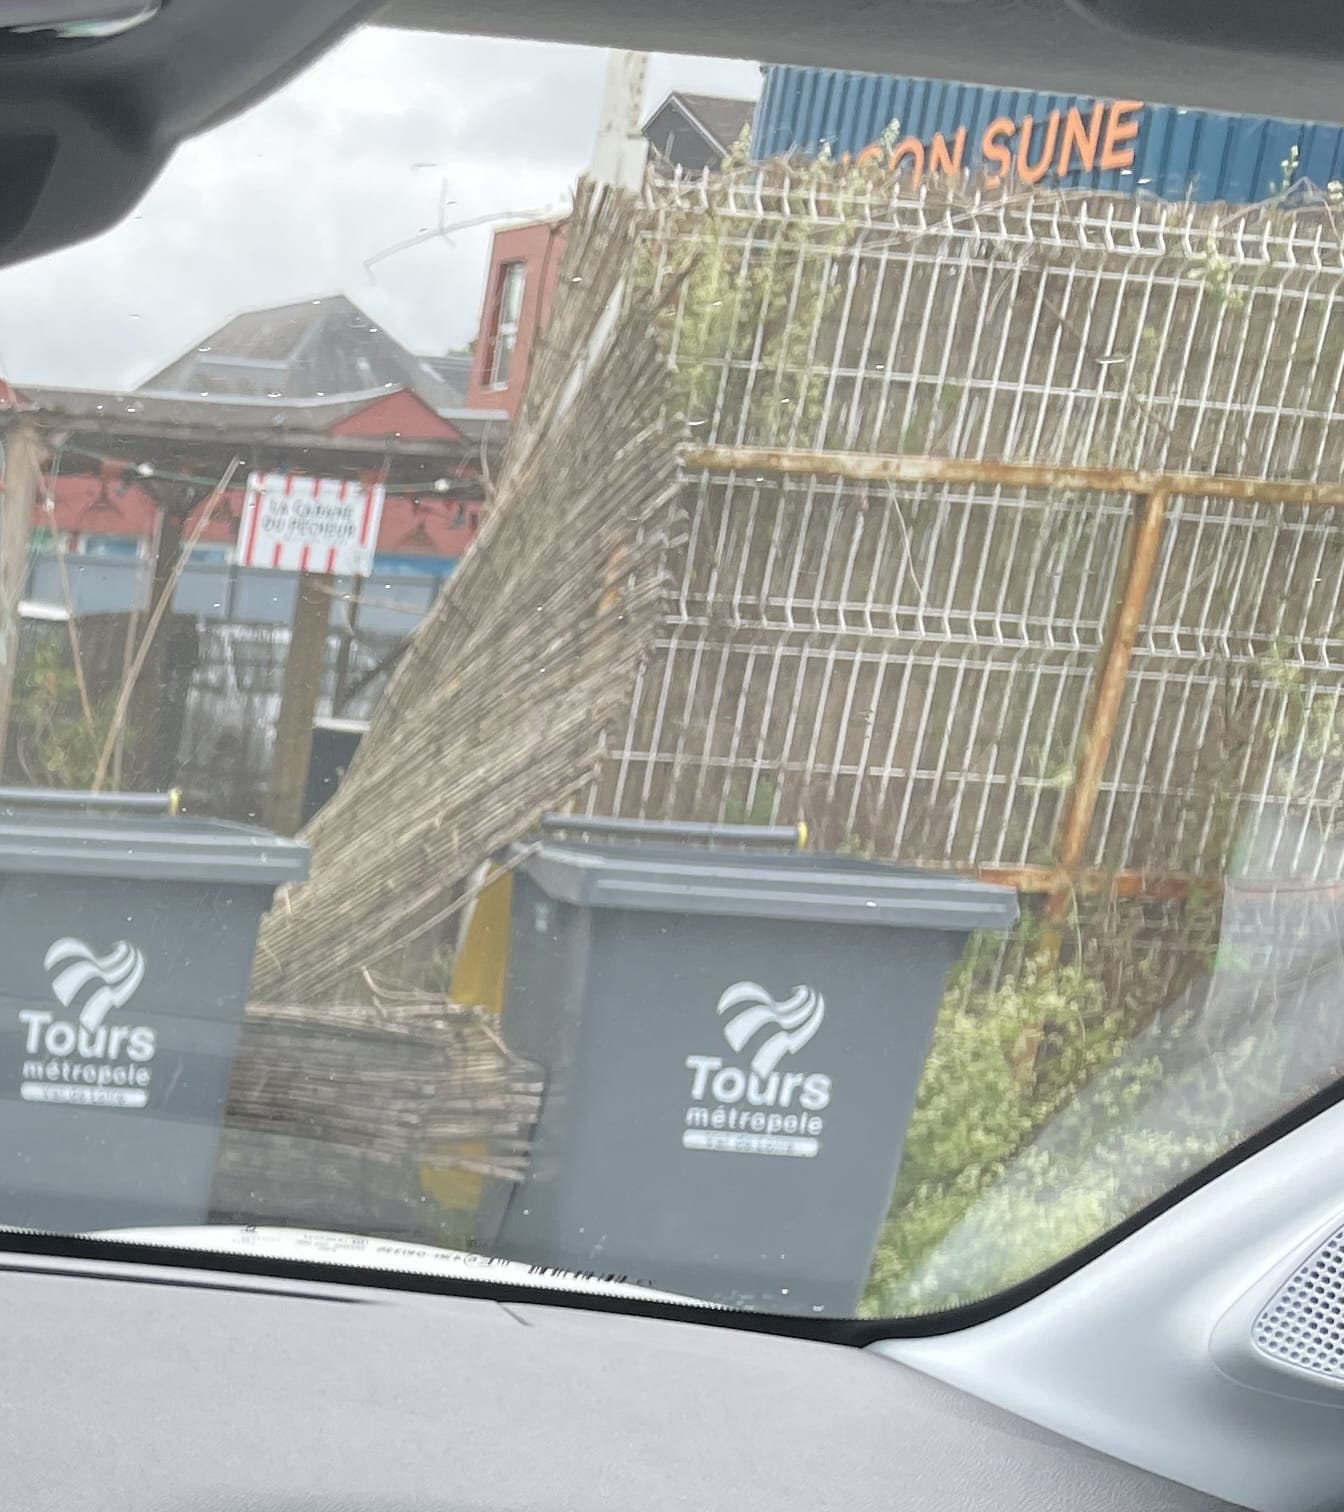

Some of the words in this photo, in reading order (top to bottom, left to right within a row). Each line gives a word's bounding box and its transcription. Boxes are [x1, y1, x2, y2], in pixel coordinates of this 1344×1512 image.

[981, 100, 1144, 189] SUNE
[19, 1009, 155, 1062] Tours
[22, 1059, 151, 1087] métropole
[686, 1055, 832, 1110] Tours
[686, 1106, 824, 1135] métropole
